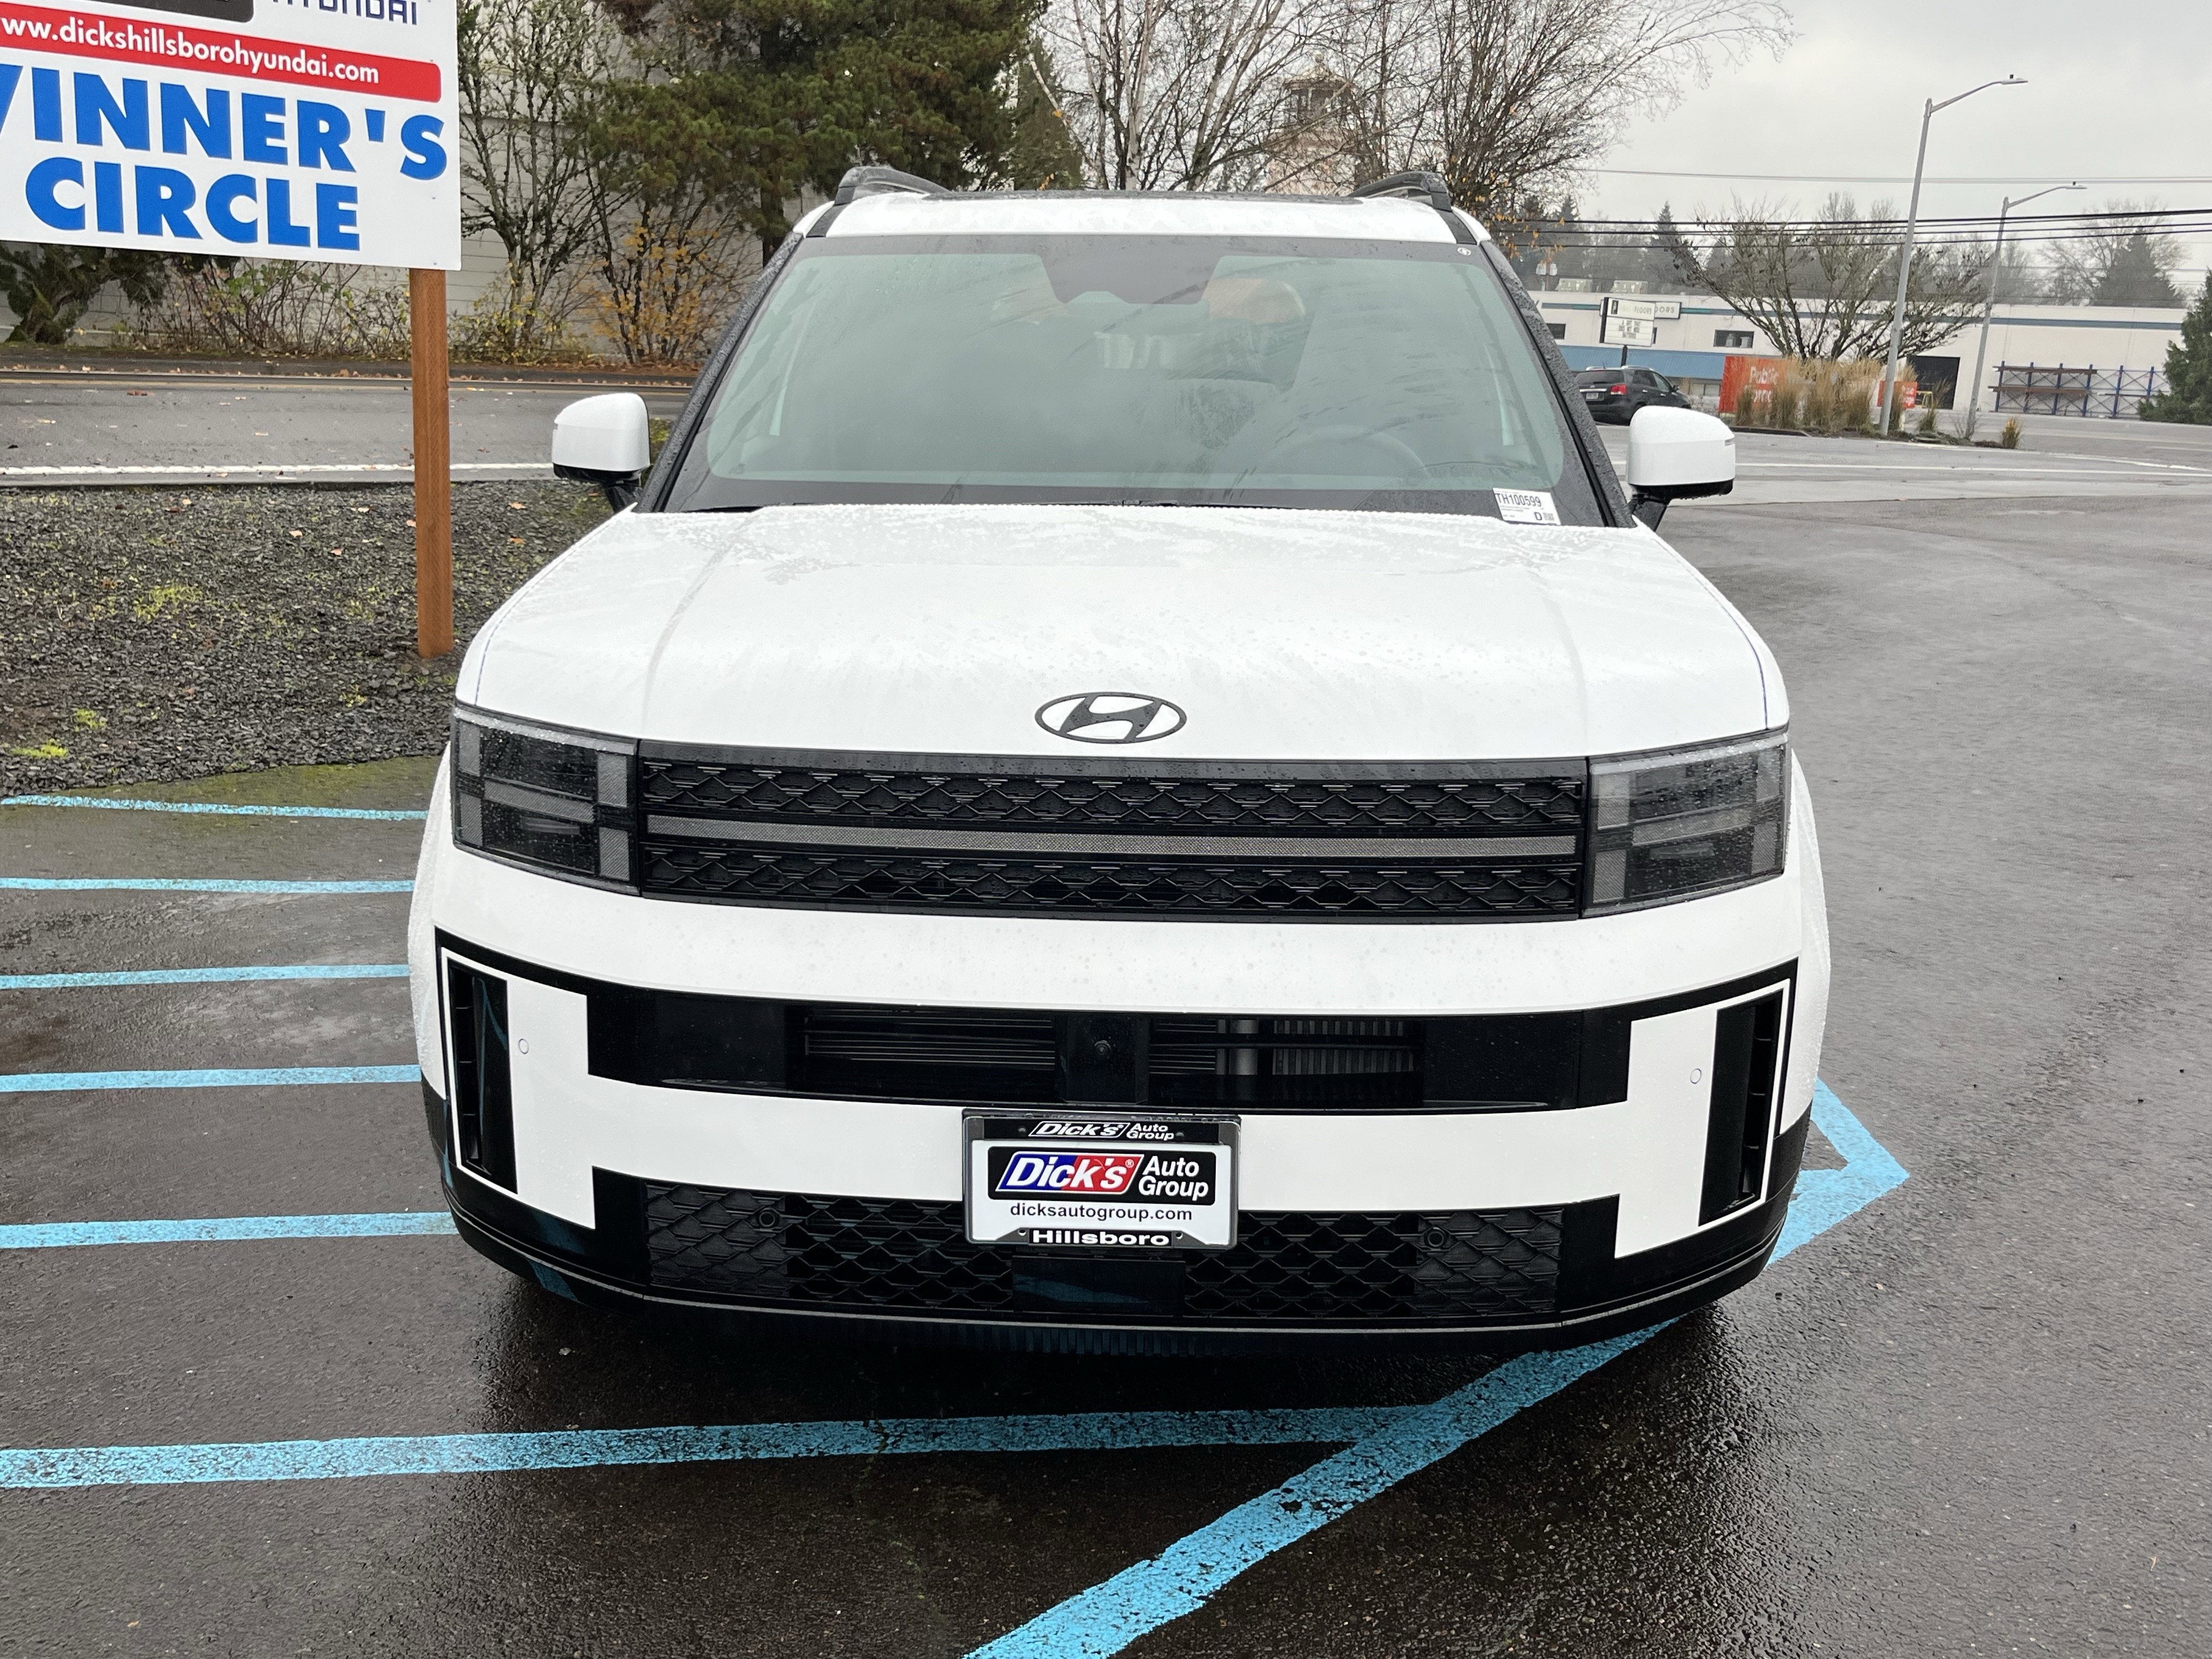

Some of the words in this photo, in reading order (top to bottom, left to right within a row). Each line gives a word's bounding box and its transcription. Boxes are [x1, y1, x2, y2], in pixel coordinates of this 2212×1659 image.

[0, 16, 379, 84] ww.dickshillsborohyundai.com
[25, 157, 360, 251] CIRCLE
[1494, 493, 1542, 507] TH100599
[1533, 511, 1543, 521] D
[1036, 1122, 1119, 1136] Dick's
[1126, 1130, 1175, 1141] Group
[1130, 1123, 1169, 1132] Auto
[1006, 1156, 1127, 1189] Dick's
[1142, 1156, 1199, 1177] Auto
[1138, 1175, 1209, 1200] Group
[1011, 1203, 1192, 1222] dicksautogroup.com
[1033, 1229, 1169, 1245] Hillsboro
